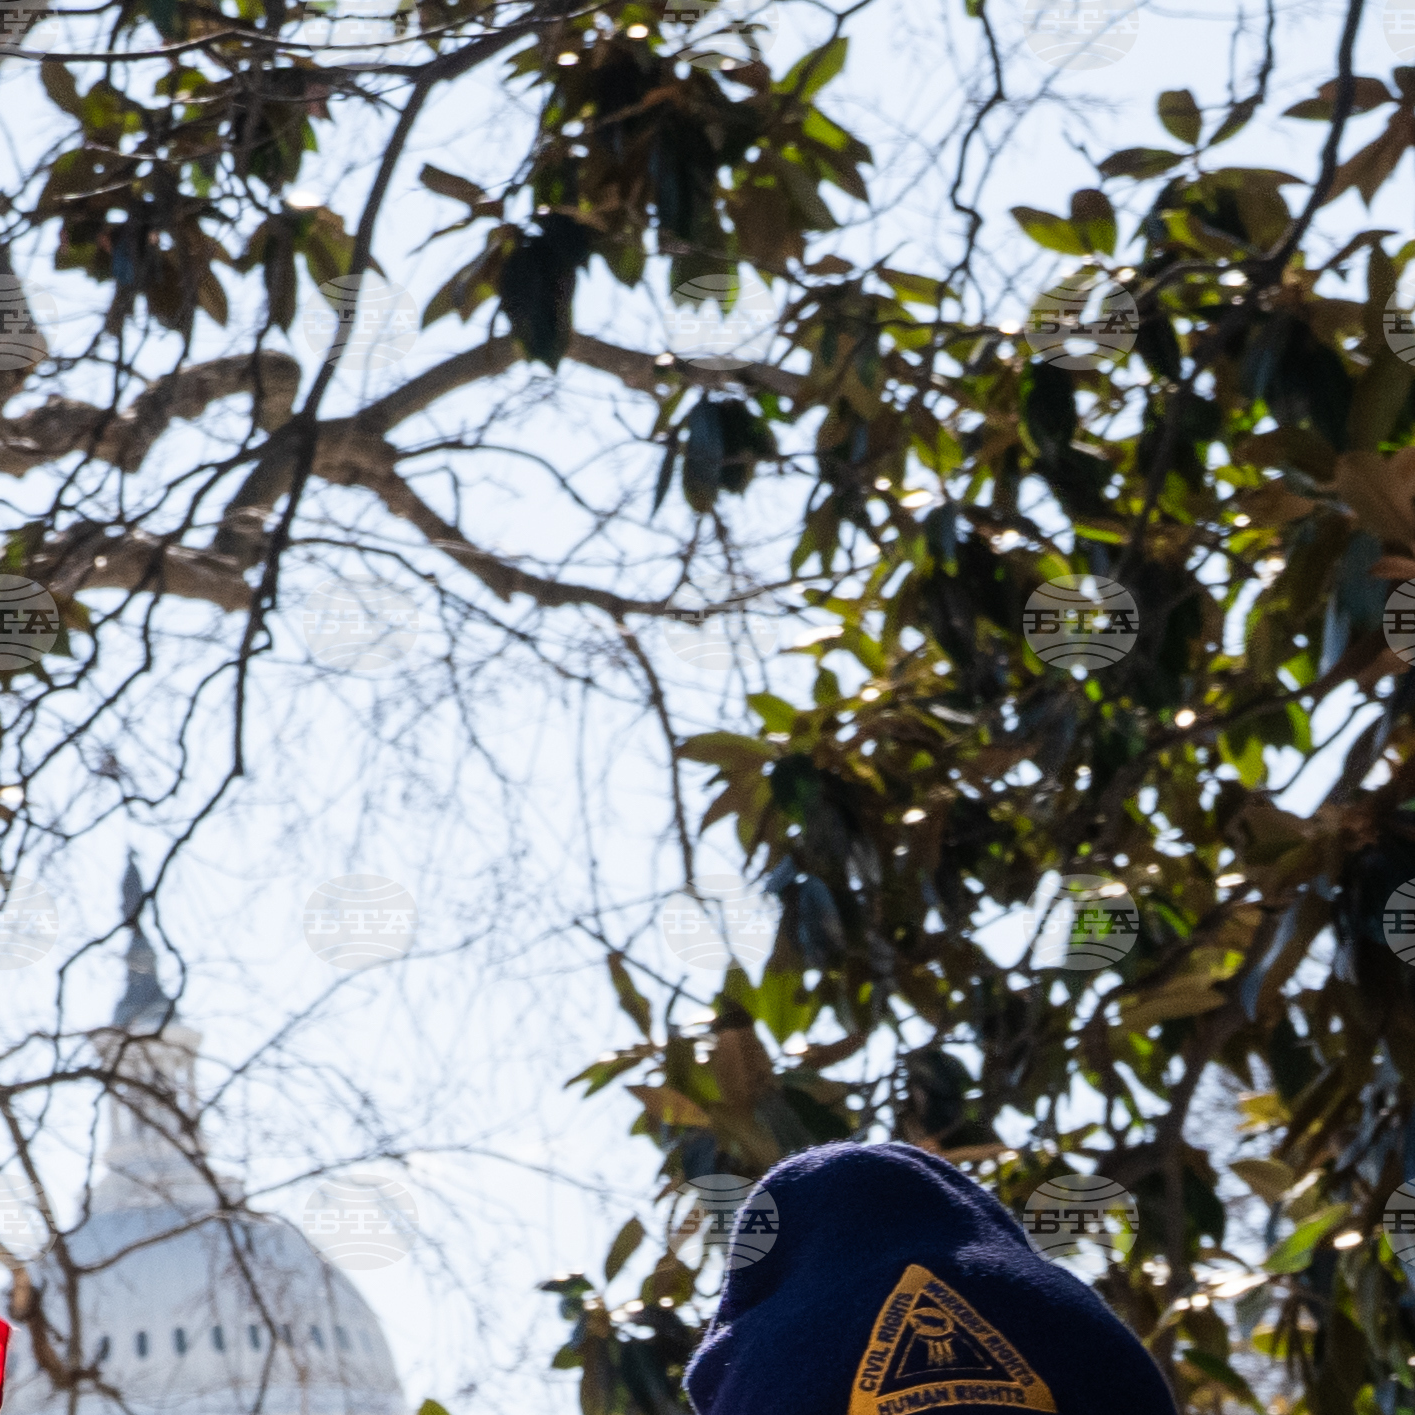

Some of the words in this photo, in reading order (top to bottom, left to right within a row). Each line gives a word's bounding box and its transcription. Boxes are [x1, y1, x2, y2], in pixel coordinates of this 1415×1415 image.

[858, 1347, 891, 1392] CIVIL
[876, 1292, 914, 1344] RIGHTS
[953, 1384, 1026, 1405] RIGHTS
